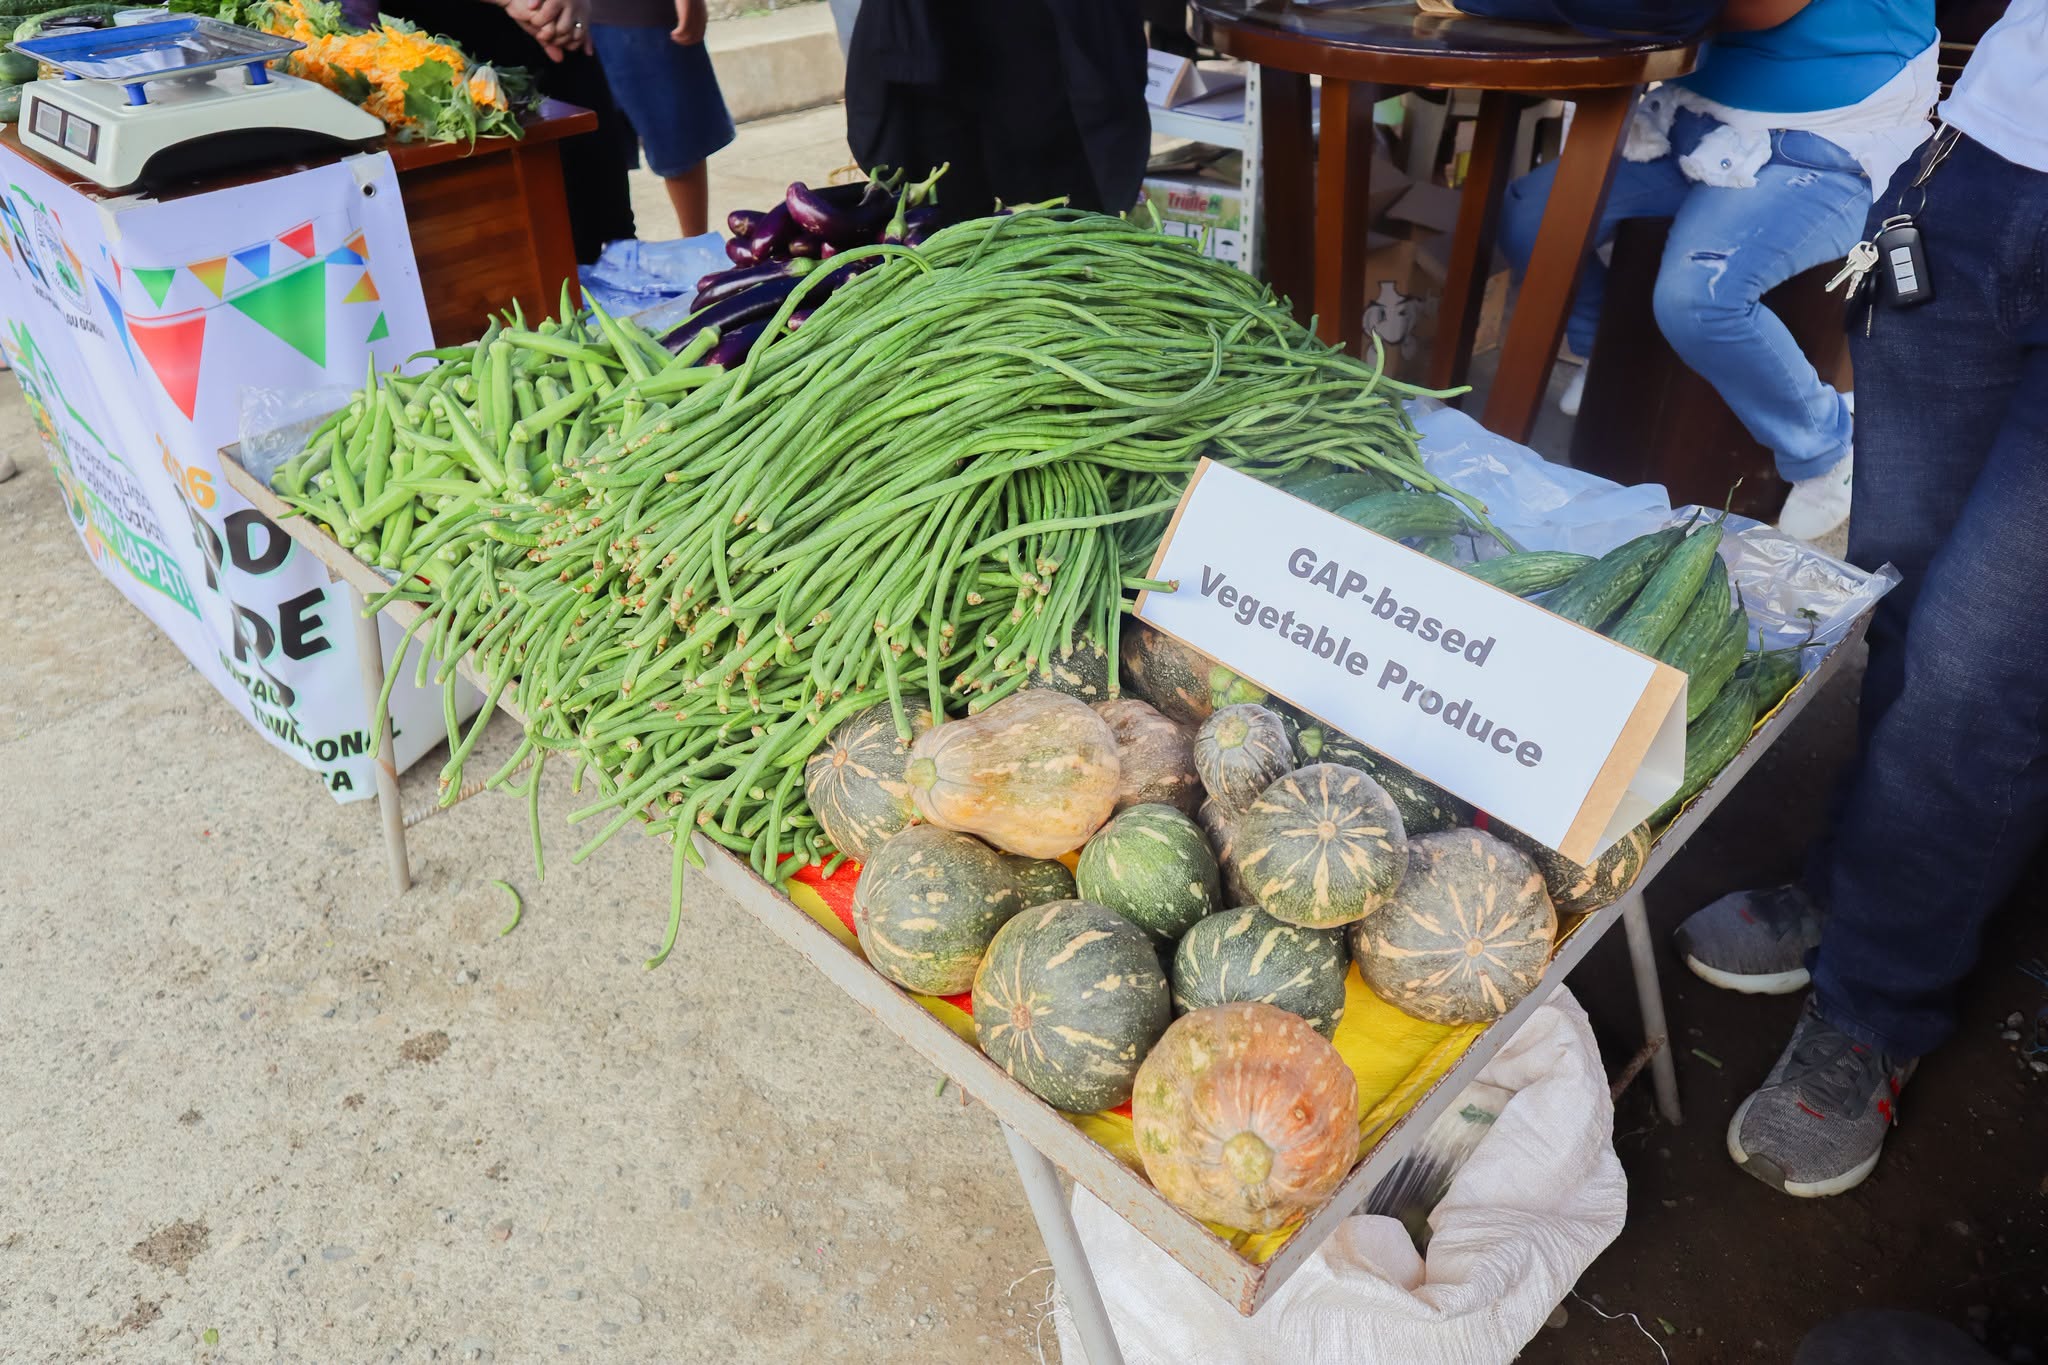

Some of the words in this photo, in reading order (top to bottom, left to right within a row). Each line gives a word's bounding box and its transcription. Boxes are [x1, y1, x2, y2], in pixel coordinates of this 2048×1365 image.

[114, 519, 196, 611] DAPAT!
[1288, 547, 1497, 668] GAP-based
[1200, 564, 1369, 676] Vegetable
[1376, 659, 1543, 768] Produce
